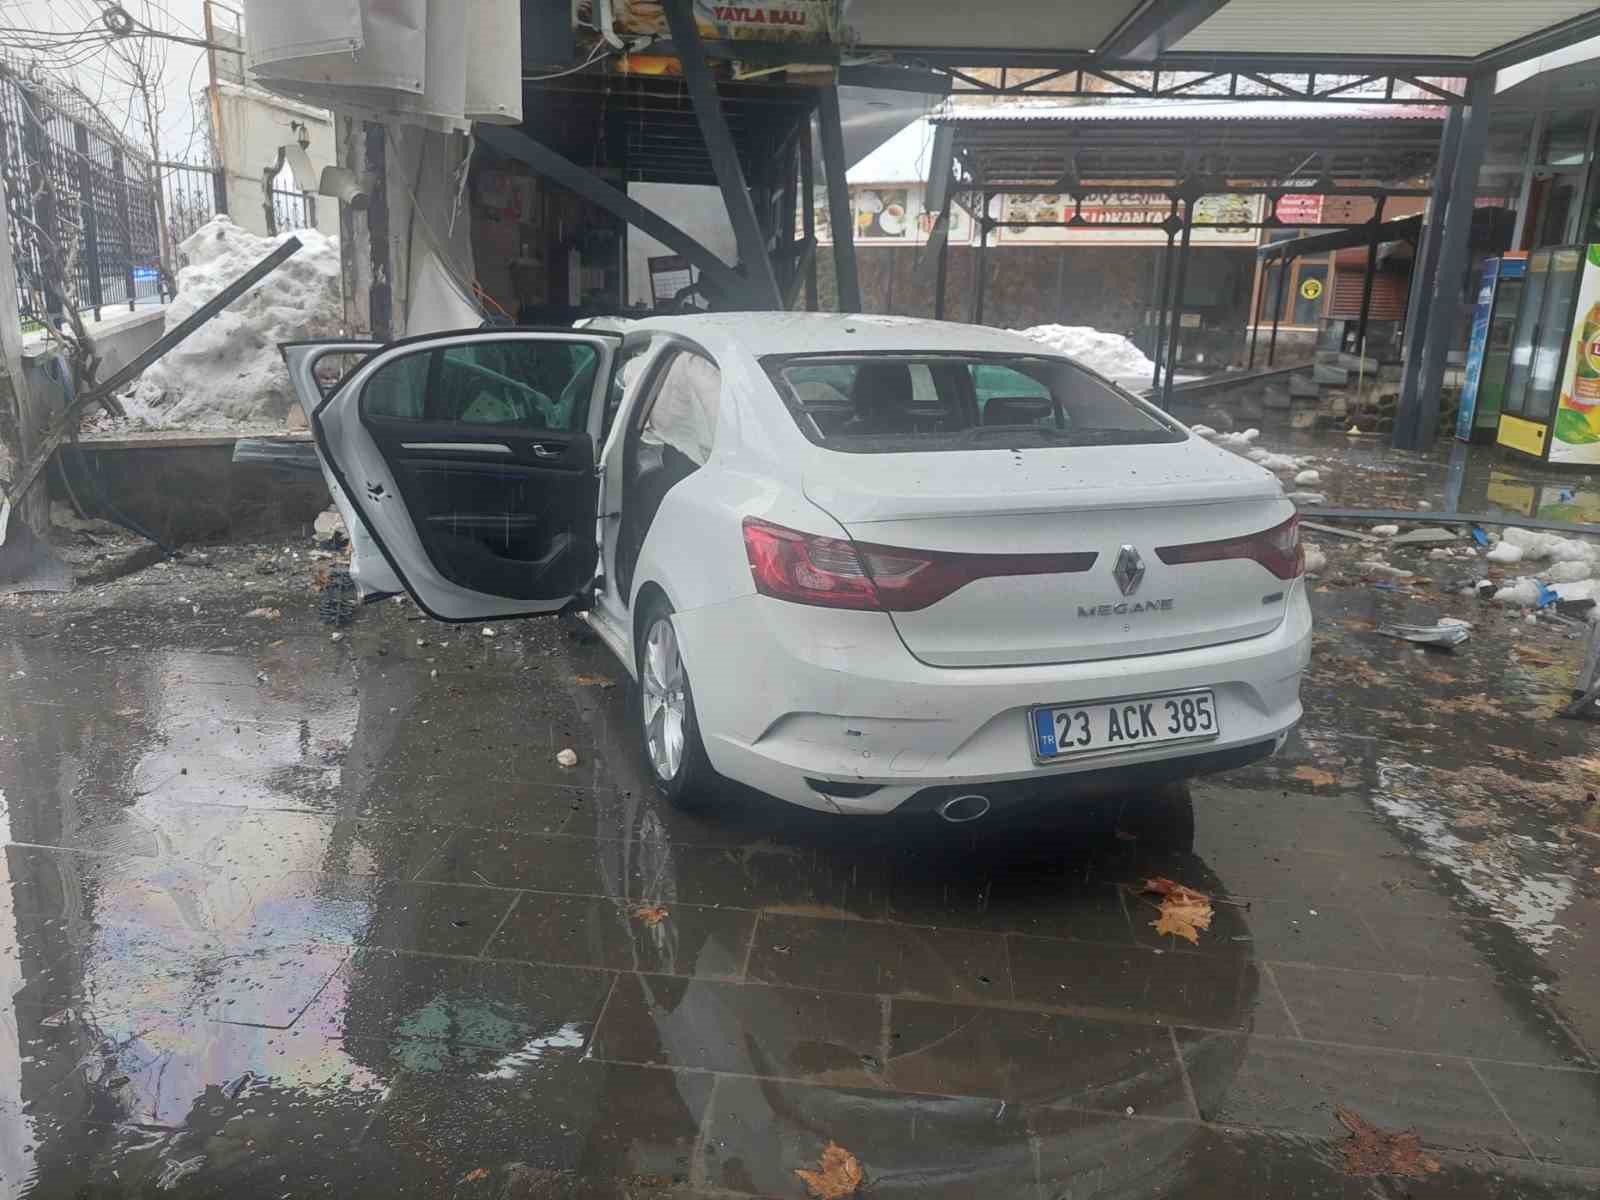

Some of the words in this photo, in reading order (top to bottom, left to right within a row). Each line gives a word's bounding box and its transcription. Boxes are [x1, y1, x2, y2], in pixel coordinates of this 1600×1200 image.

[712, 6, 765, 23] YAYLA
[1077, 599, 1174, 618] MEGANE
[1041, 735, 1055, 745] TR
[1056, 711, 1092, 748] 23
[1108, 704, 1157, 742] ACK
[1165, 697, 1213, 735] 385
